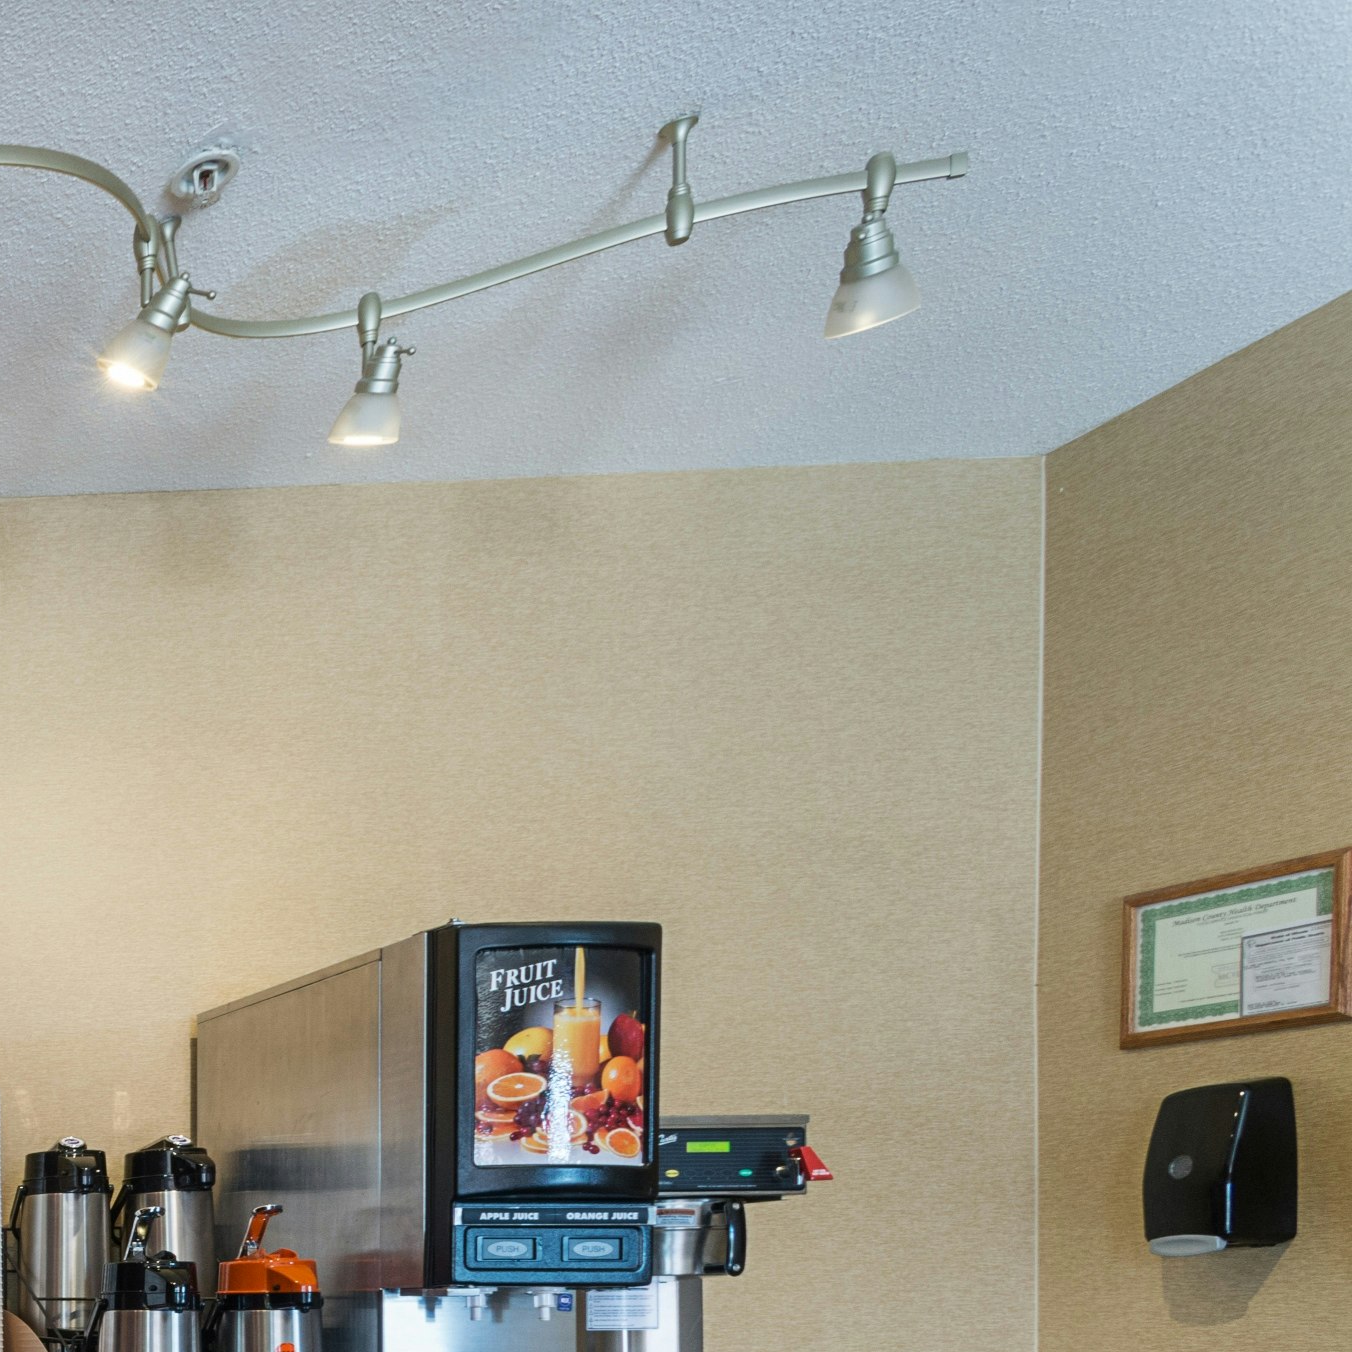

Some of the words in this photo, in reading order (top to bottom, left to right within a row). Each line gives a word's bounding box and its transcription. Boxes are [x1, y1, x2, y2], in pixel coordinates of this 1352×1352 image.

[1255, 897, 1297, 911] Department
[489, 959, 557, 992] FRUIT
[500, 979, 564, 1012] JUICE
[479, 1212, 510, 1220] APPLE
[512, 1212, 539, 1220] JUICE
[566, 1212, 609, 1220] ORANGE
[611, 1212, 639, 1220] JUICE
[496, 1245, 519, 1253] PUSH
[582, 1245, 605, 1253] PUSH
